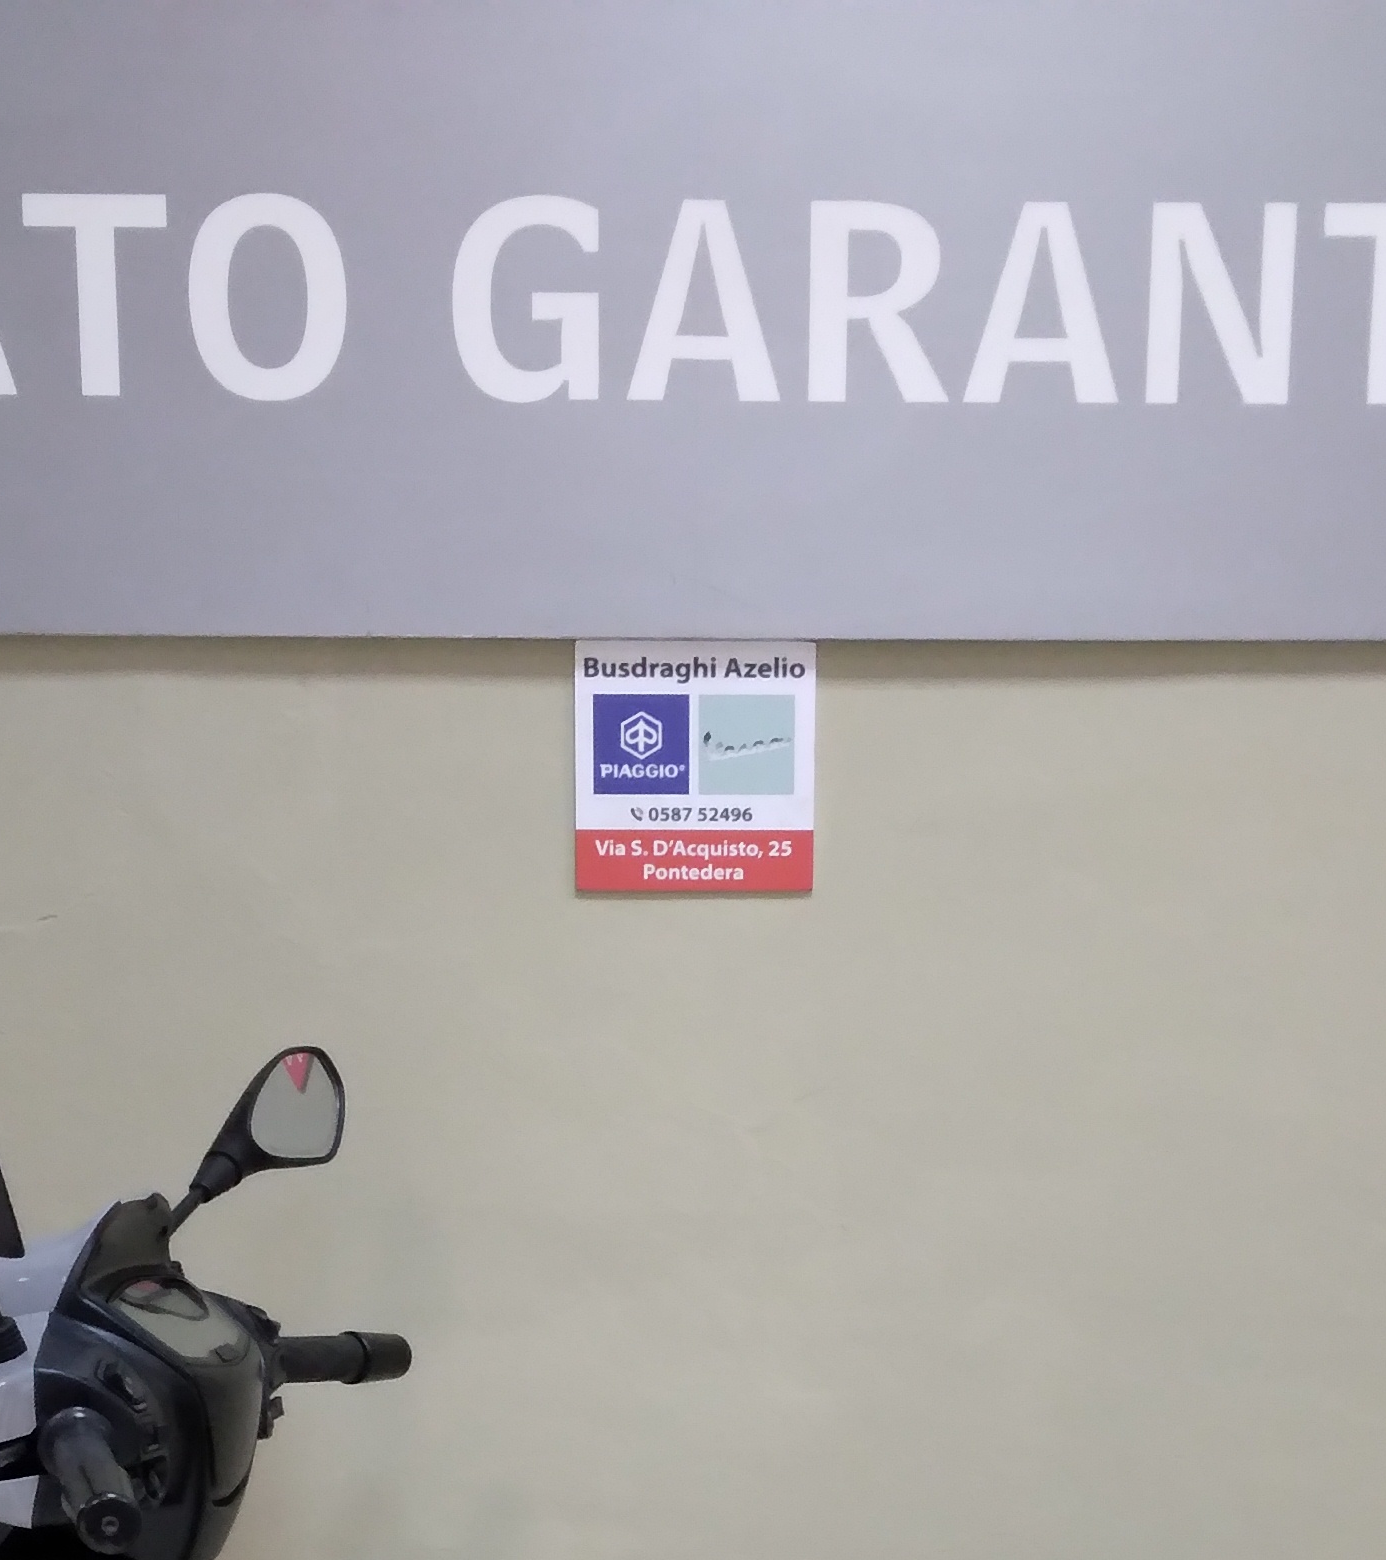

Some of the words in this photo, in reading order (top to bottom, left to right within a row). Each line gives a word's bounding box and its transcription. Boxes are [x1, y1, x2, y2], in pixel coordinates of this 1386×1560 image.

[583, 656, 717, 684] Busdraghi
[724, 656, 806, 679] Azelio
[648, 807, 692, 822] 0587
[697, 807, 753, 822] 52496
[595, 840, 626, 857] Via
[630, 840, 649, 857] S.
[768, 840, 793, 857] 25
[643, 864, 745, 881] Pontedera
